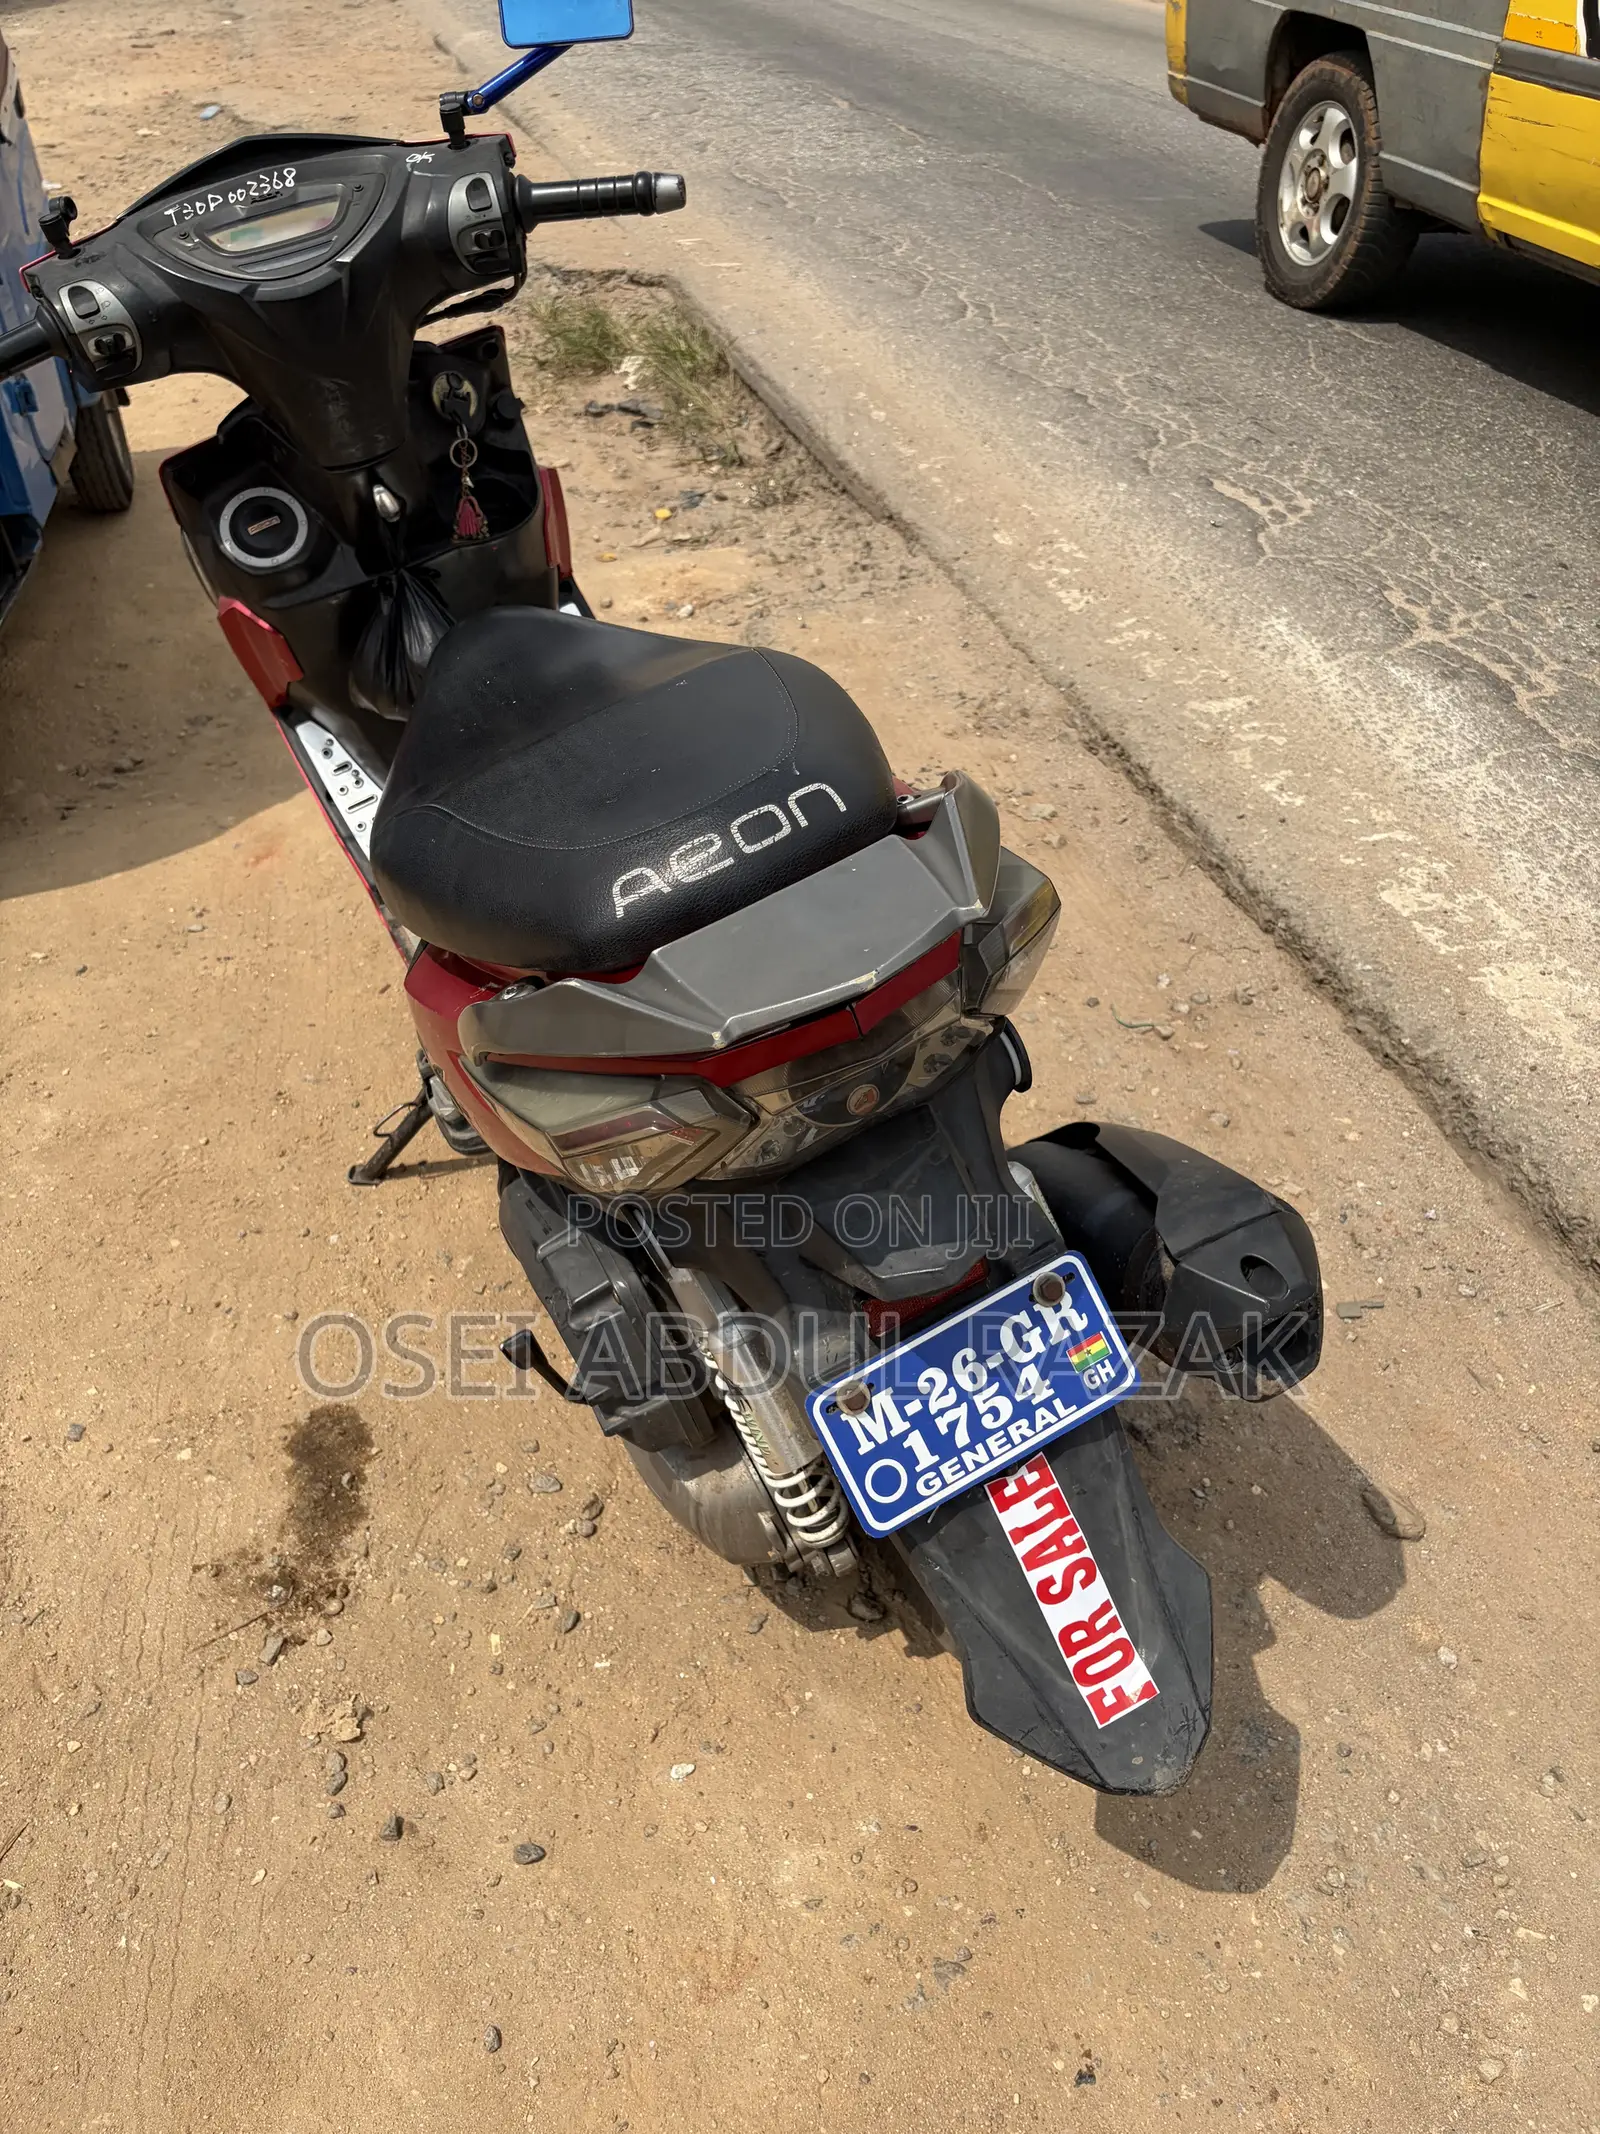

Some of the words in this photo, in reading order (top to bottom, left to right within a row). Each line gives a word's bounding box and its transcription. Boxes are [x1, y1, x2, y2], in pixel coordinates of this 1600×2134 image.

[841, 1288, 1088, 1455] M-26-GR
[903, 1363, 1054, 1472] 1754
[1083, 1359, 1116, 1390] GH
[916, 1398, 1077, 1496] GENERAL
[985, 1453, 1097, 1605] SALE
[1058, 1598, 1159, 1726] FOR
